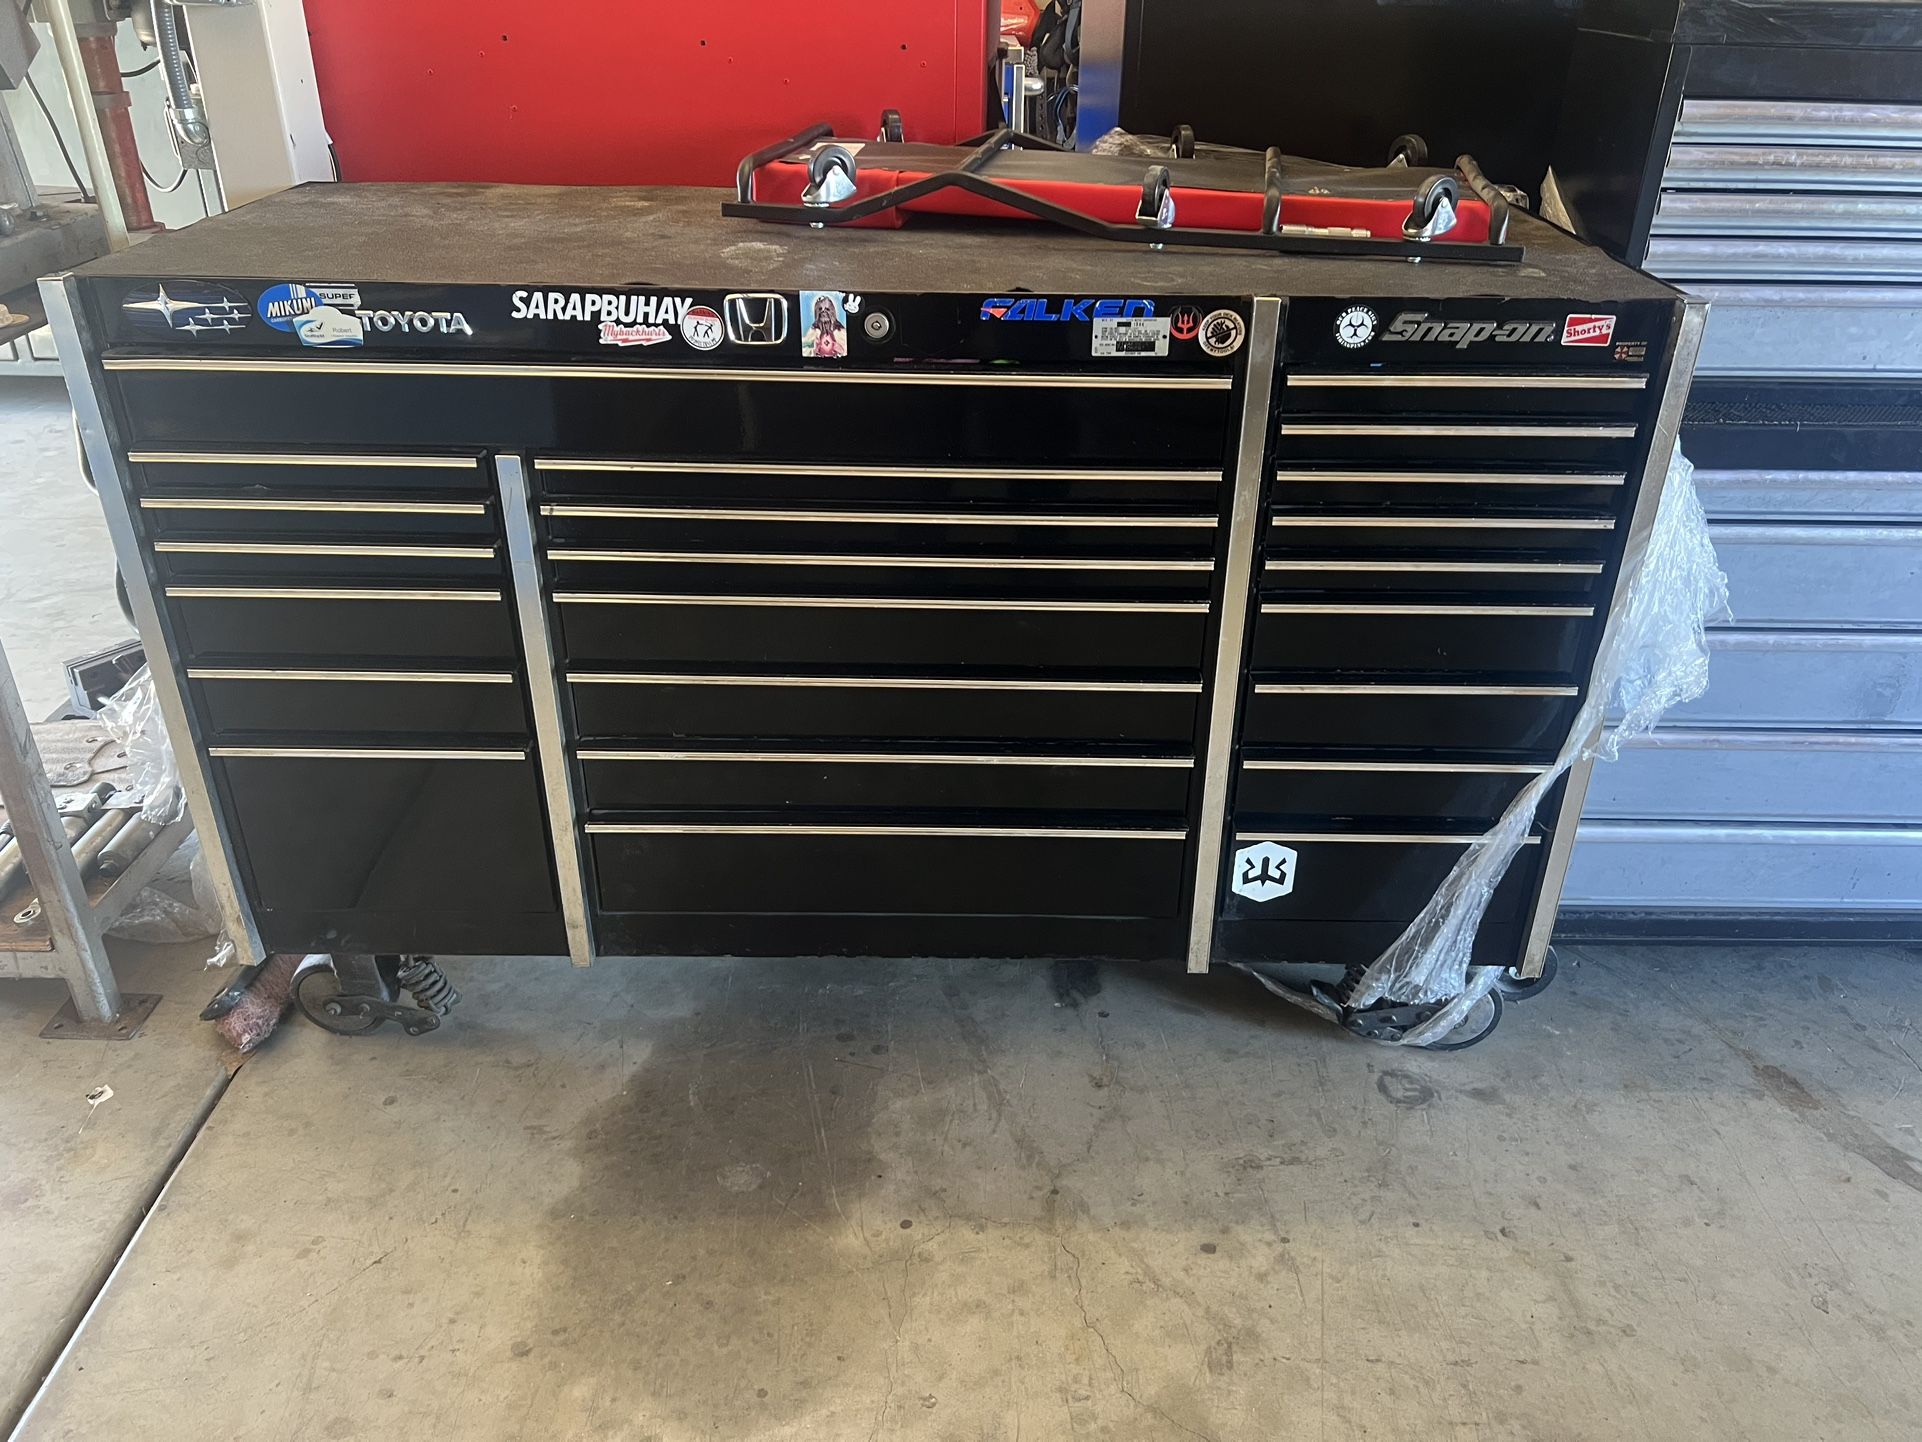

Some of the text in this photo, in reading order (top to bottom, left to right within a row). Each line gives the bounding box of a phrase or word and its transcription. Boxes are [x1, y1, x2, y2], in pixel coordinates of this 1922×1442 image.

[266, 297, 316, 318] MIKUNI
[511, 290, 693, 325] SARAPBUHAY
[980, 297, 1156, 321] FALKEN
[1347, 306, 1368, 314] PEACE
[356, 310, 473, 336] TOYOTA
[1380, 311, 1555, 349] Snap-on
[1565, 320, 1612, 339] Shorty's
